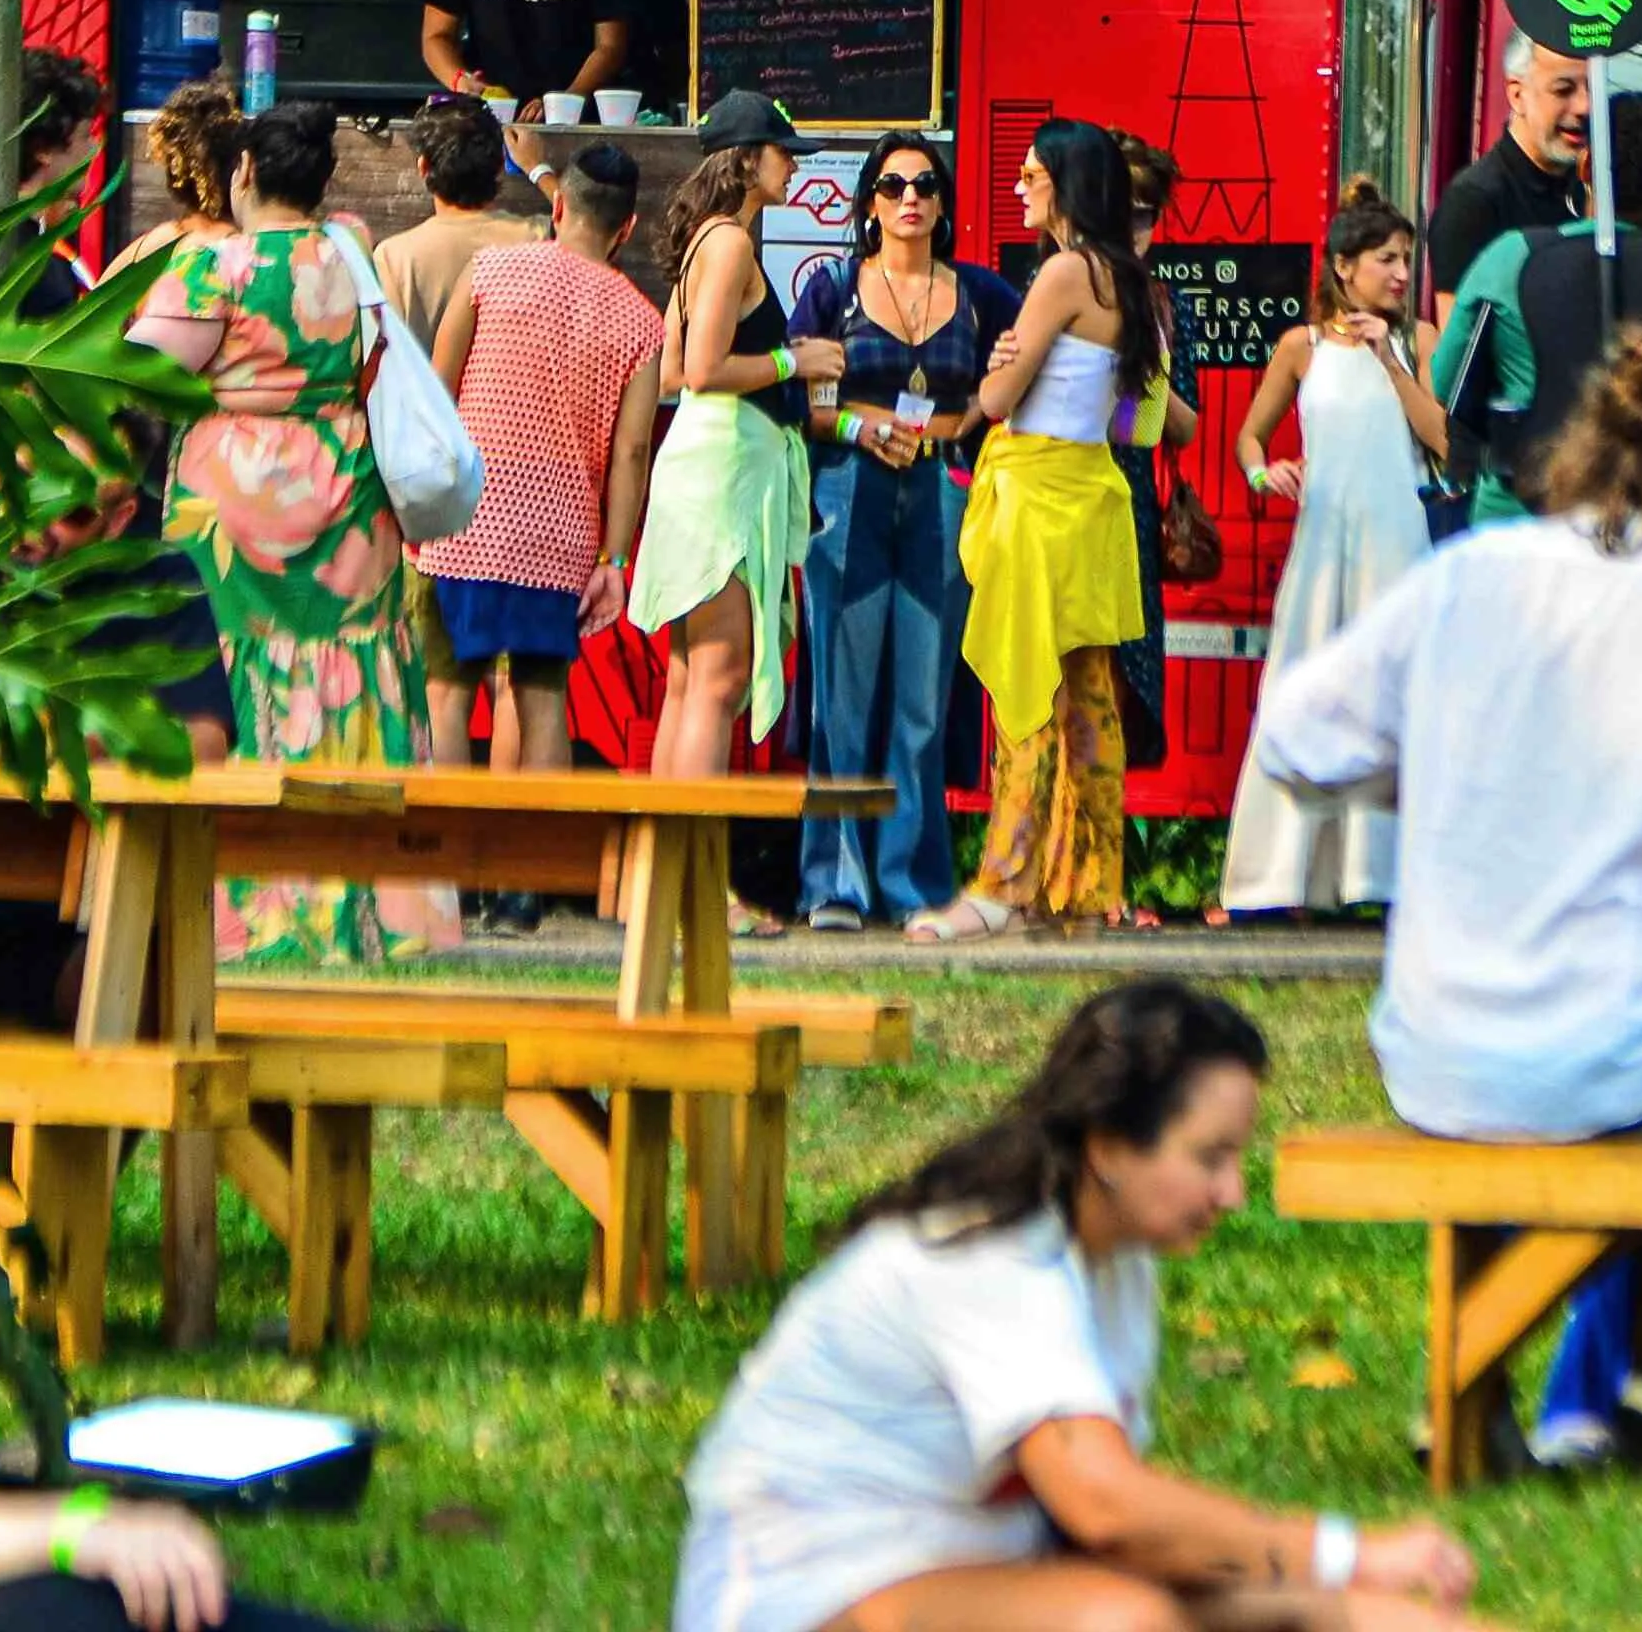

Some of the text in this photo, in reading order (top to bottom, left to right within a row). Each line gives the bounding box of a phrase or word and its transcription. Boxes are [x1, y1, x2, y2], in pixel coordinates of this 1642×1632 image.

[1150, 263, 1203, 280] -NOS
[1194, 297, 1300, 317] ERSCO
[1204, 321, 1263, 339] UTA
[1194, 342, 1277, 362] RUCK
